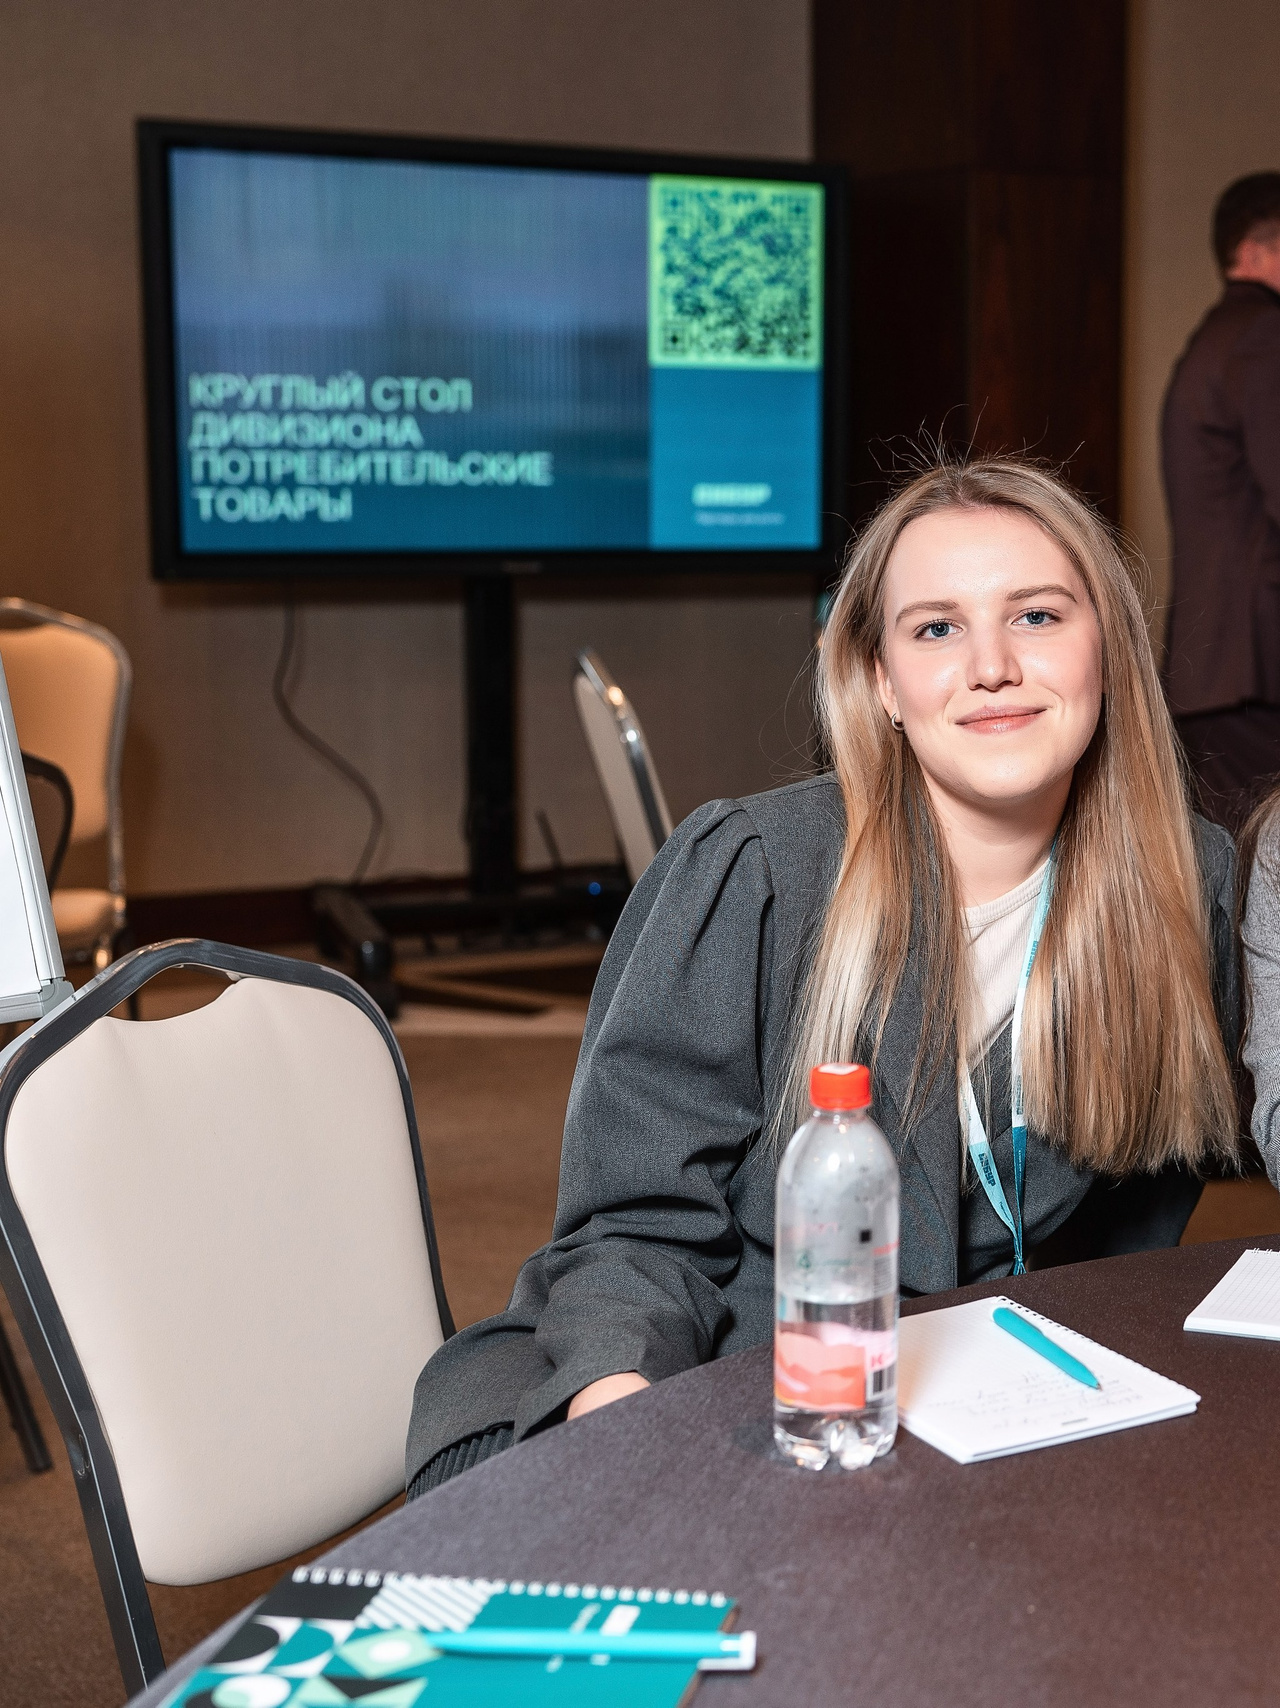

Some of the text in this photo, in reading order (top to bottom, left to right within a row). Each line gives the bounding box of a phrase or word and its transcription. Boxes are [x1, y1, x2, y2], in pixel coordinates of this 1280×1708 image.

[189, 371, 473, 413] КРУГЛЫЙ СТОЛ
[188, 411, 424, 449] ДИВИЗИОНА
[191, 449, 554, 486] ПОТРЕБИТЕЛЬСКИЕ
[193, 485, 353, 522] ТОВАРЫ
